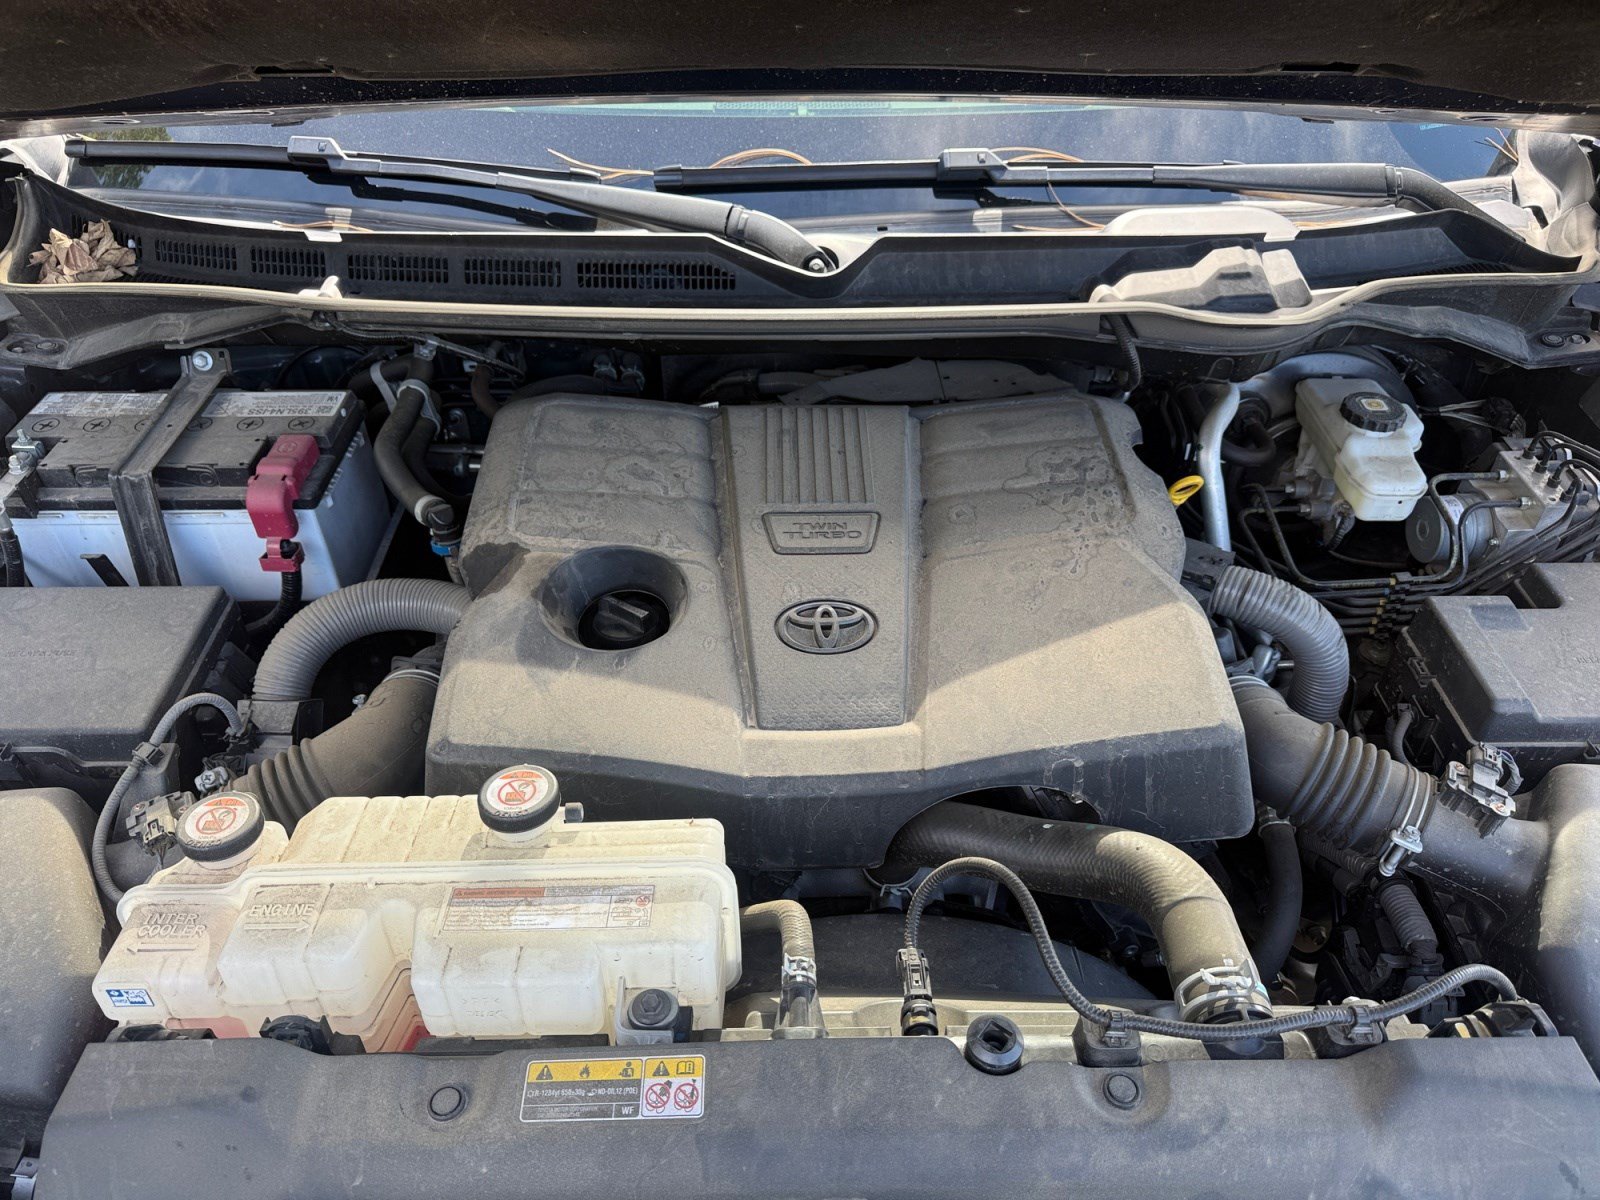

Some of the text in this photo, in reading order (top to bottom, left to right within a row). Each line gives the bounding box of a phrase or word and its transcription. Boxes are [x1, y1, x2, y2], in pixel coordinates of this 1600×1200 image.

[792, 522, 847, 530] TWIN
[783, 530, 862, 539] TURBO
[249, 903, 316, 917] ENGINE
[143, 913, 199, 925] INTER
[137, 924, 207, 938] COOLER
[621, 1106, 635, 1115] WF
